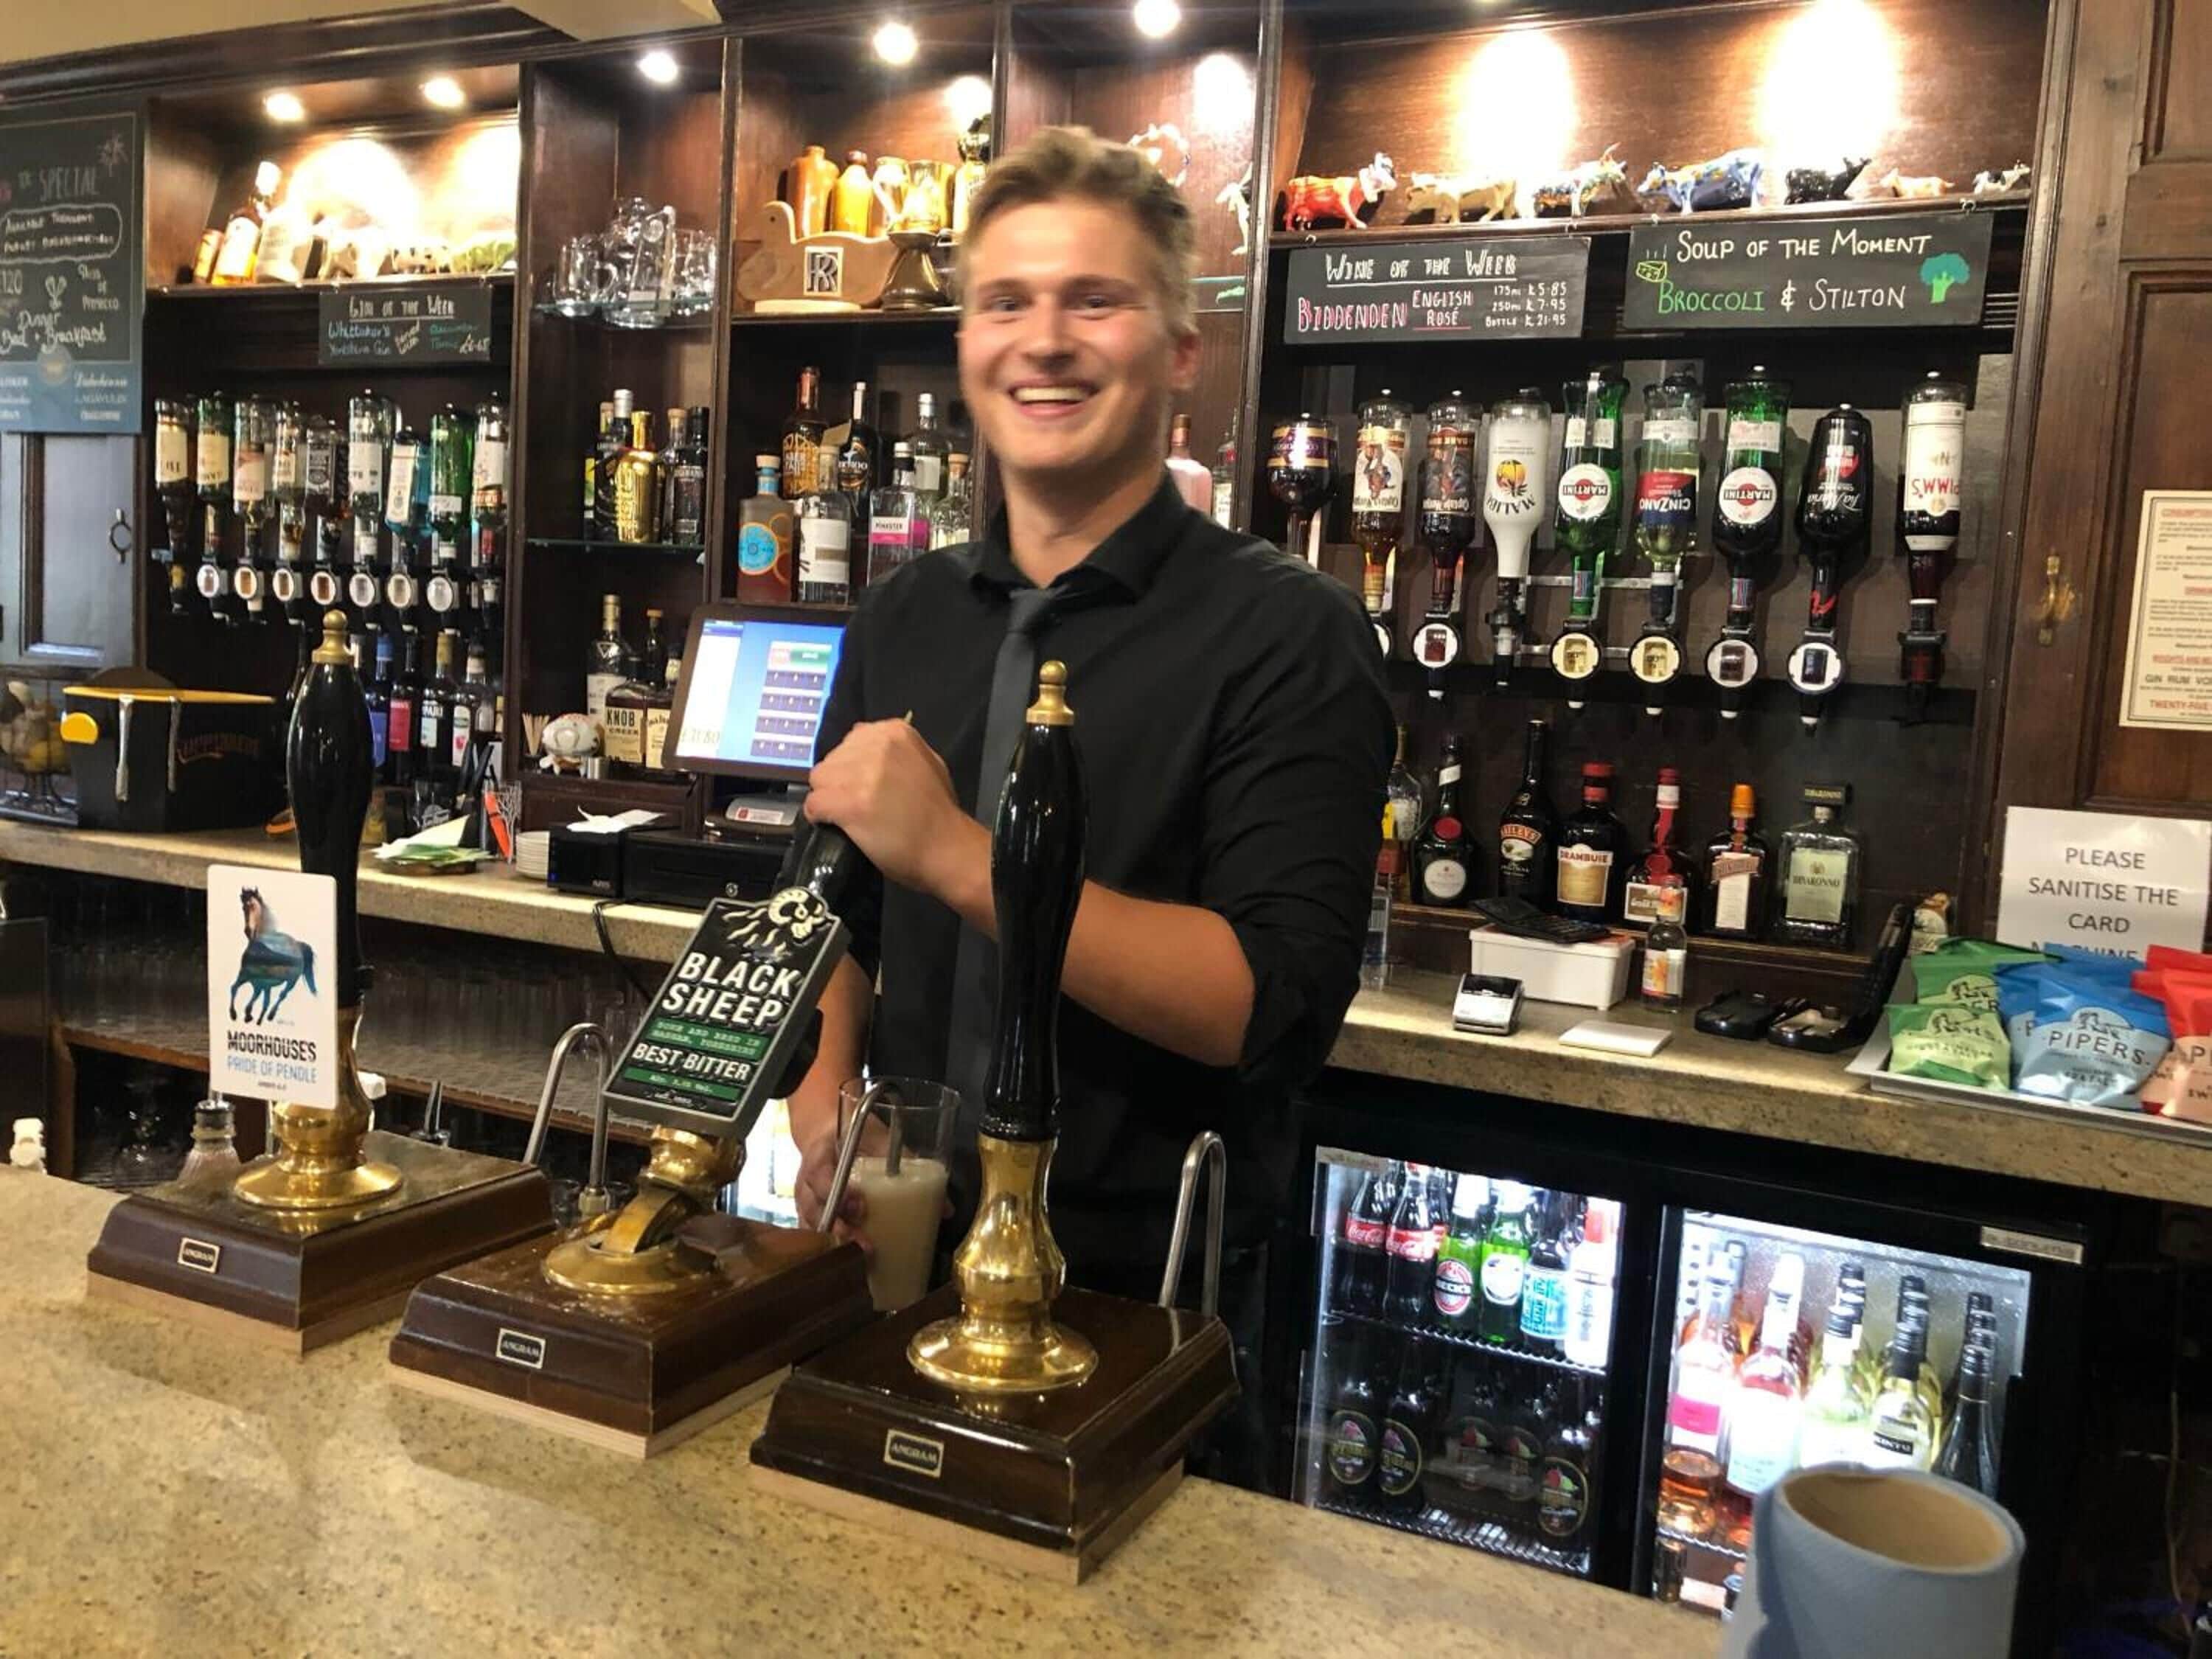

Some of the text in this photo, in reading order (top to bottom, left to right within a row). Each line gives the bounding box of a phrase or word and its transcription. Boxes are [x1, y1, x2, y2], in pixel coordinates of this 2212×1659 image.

[1677, 227, 1933, 262] SOUP OF THE MOMENT
[1326, 248, 1517, 282] WINE OF THE WEEK
[1298, 289, 1473, 333] BIDDENDEN ENGLISH
[1658, 277, 1906, 314] BROCCOLI & STILTON
[1426, 307, 1459, 327] ROSÉ
[1639, 497, 1691, 511] CINZANO
[607, 709, 635, 727] KNOB
[2065, 846, 2146, 870] PLEASE
[2028, 877, 2179, 906] SANITISE THE
[2067, 913, 2130, 933] CARD
[678, 951, 802, 997] BLACK
[662, 982, 783, 1027] SHEEP
[632, 1043, 752, 1081] BEST BITTER
[2048, 1030, 2146, 1066] PIPERS
[227, 1054, 257, 1076] PRIDE
[276, 1062, 318, 1084] PENDLE
